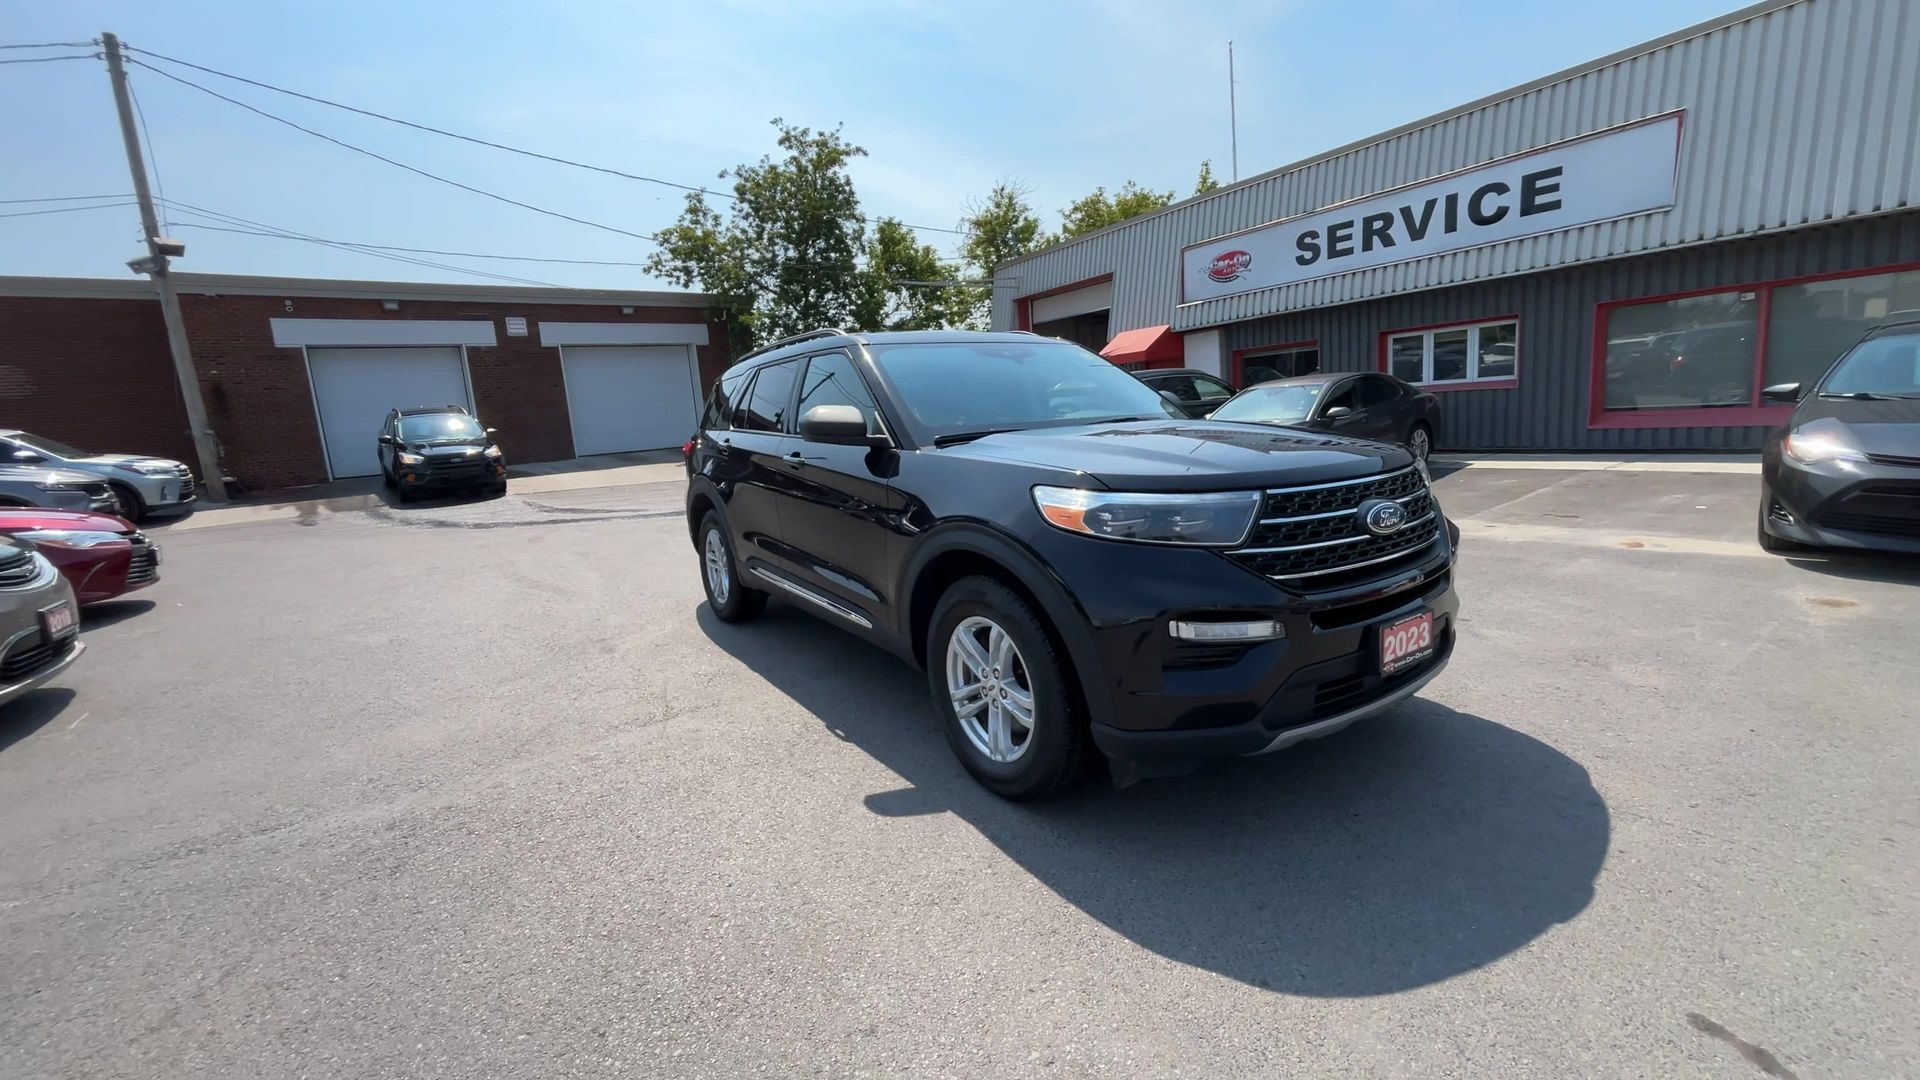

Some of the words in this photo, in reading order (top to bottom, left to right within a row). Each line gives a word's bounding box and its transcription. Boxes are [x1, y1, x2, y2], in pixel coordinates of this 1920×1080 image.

[1295, 166, 1563, 266] SERVICE
[1380, 509, 1400, 527] Ford
[1384, 622, 1430, 664] 2023
